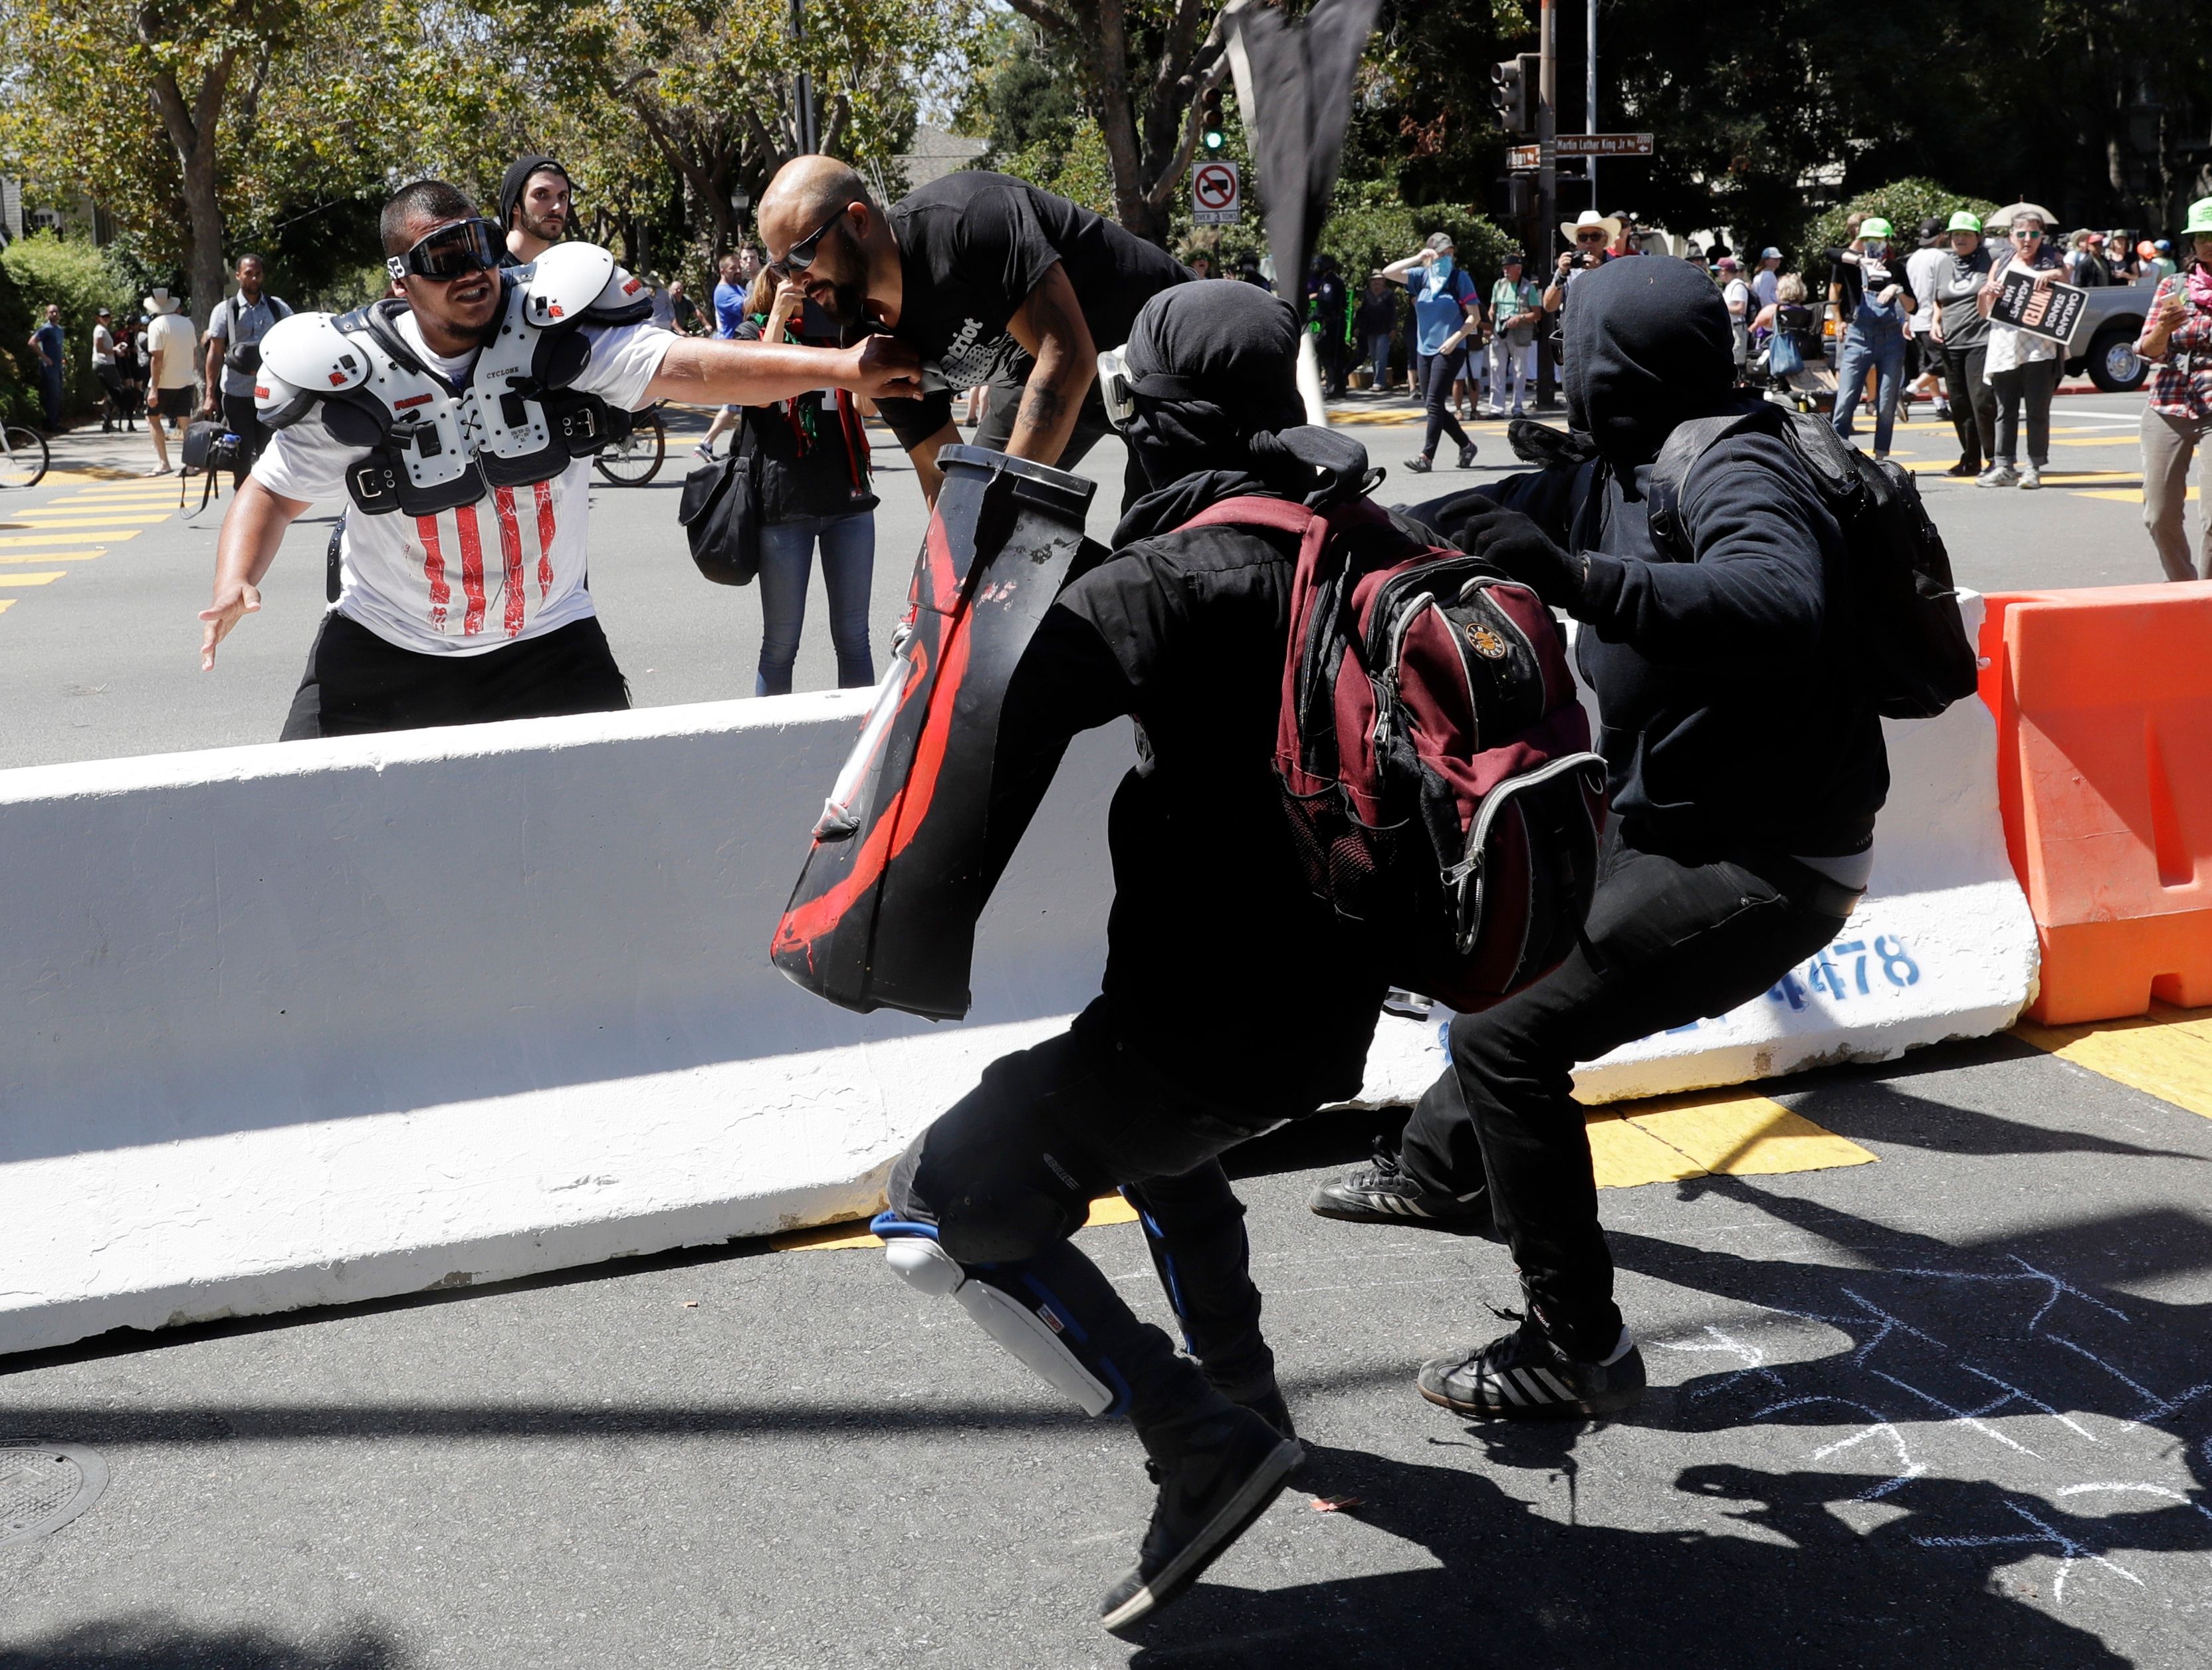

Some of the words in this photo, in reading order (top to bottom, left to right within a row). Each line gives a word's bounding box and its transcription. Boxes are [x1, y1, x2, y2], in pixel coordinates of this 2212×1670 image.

[1557, 140, 1577, 150] Martin
[1579, 139, 1599, 150] Luther
[1602, 138, 1616, 152] King
[1618, 138, 1625, 149] Jr
[1636, 135, 1650, 144] 2200
[2000, 285, 2016, 308] HATE
[2009, 280, 2031, 320] AGAINST
[2045, 293, 2066, 328] STANDS
[2055, 293, 2080, 336] OAKLAND
[939, 318, 984, 370] atriot
[487, 366, 518, 379] CYCLONE
